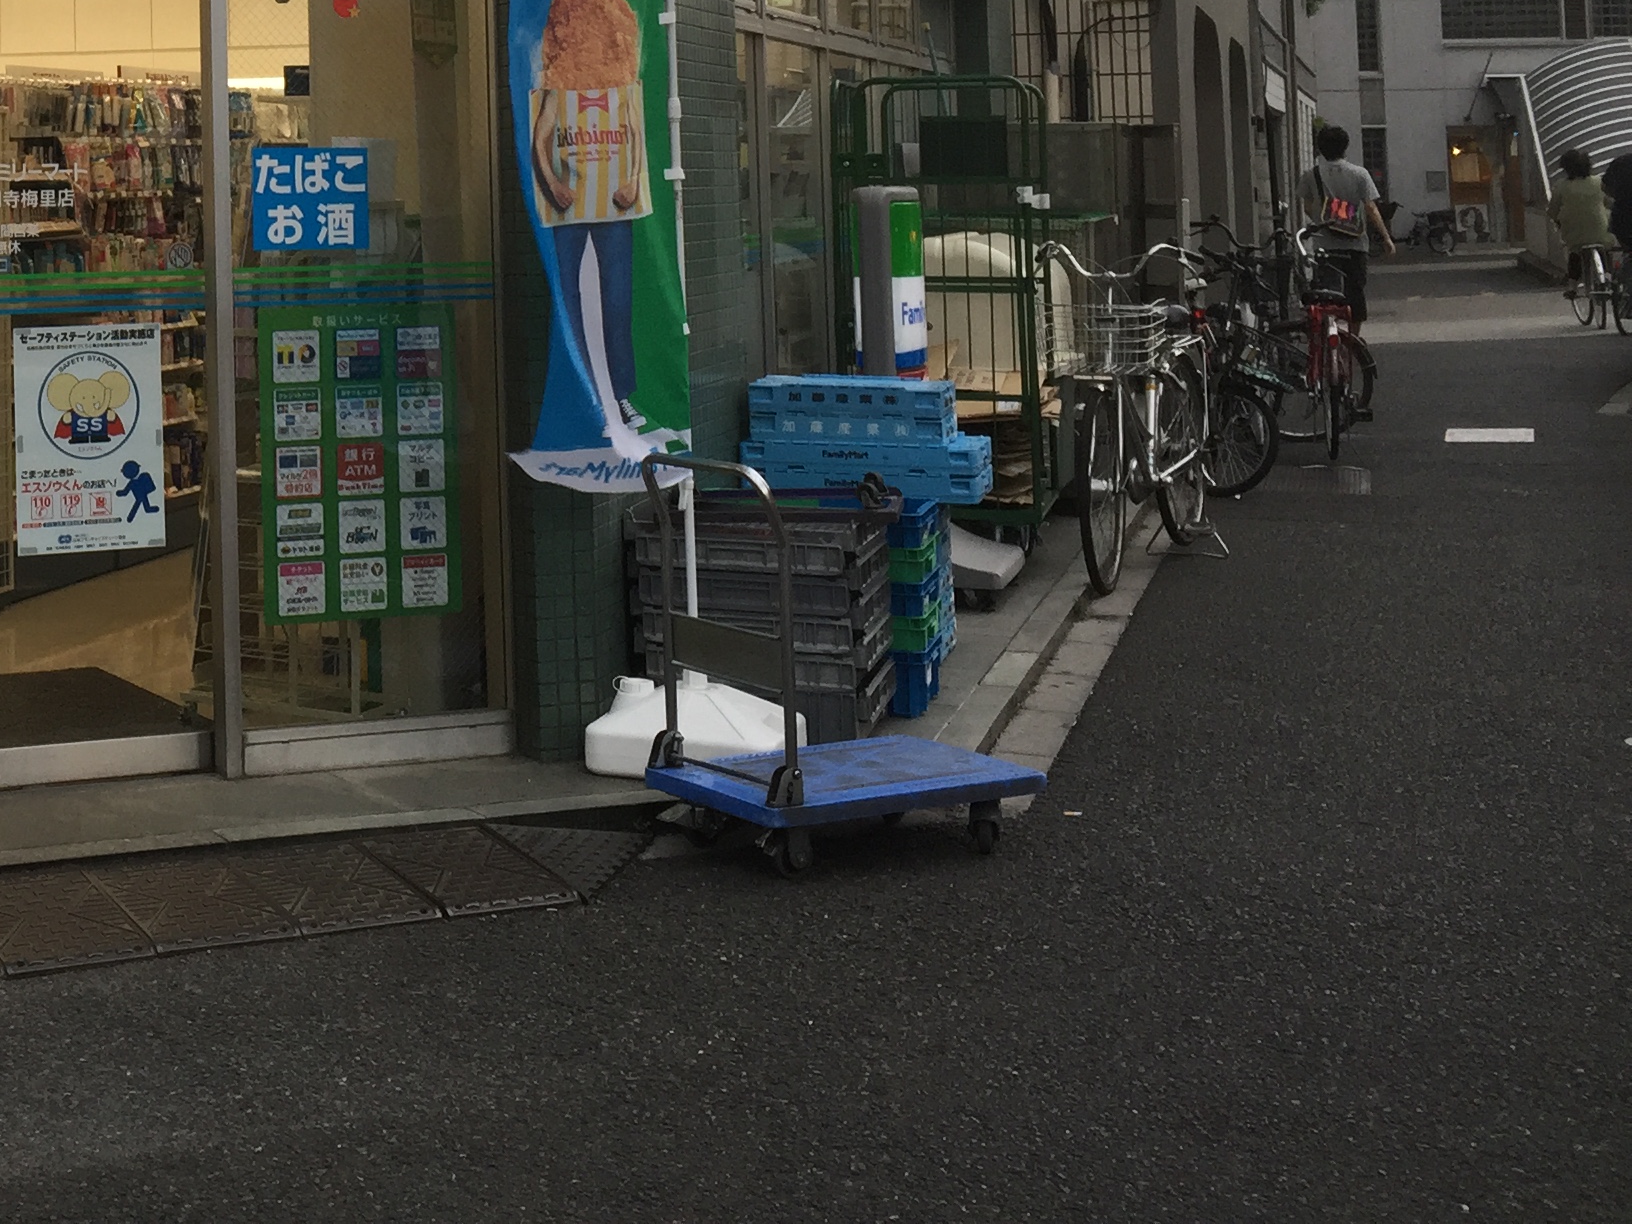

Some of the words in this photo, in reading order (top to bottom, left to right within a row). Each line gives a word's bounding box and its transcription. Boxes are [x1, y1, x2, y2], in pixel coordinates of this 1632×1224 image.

[255, 153, 367, 194] たばこ
[267, 202, 356, 246] お酒
[312, 313, 402, 327] 取扱いサービス
[58, 355, 85, 373] SAFETY
[87, 355, 118, 370] STATION
[76, 417, 103, 433] SS
[344, 447, 376, 462] 銀行
[345, 463, 377, 478] ATM
[32, 496, 52, 508] 110
